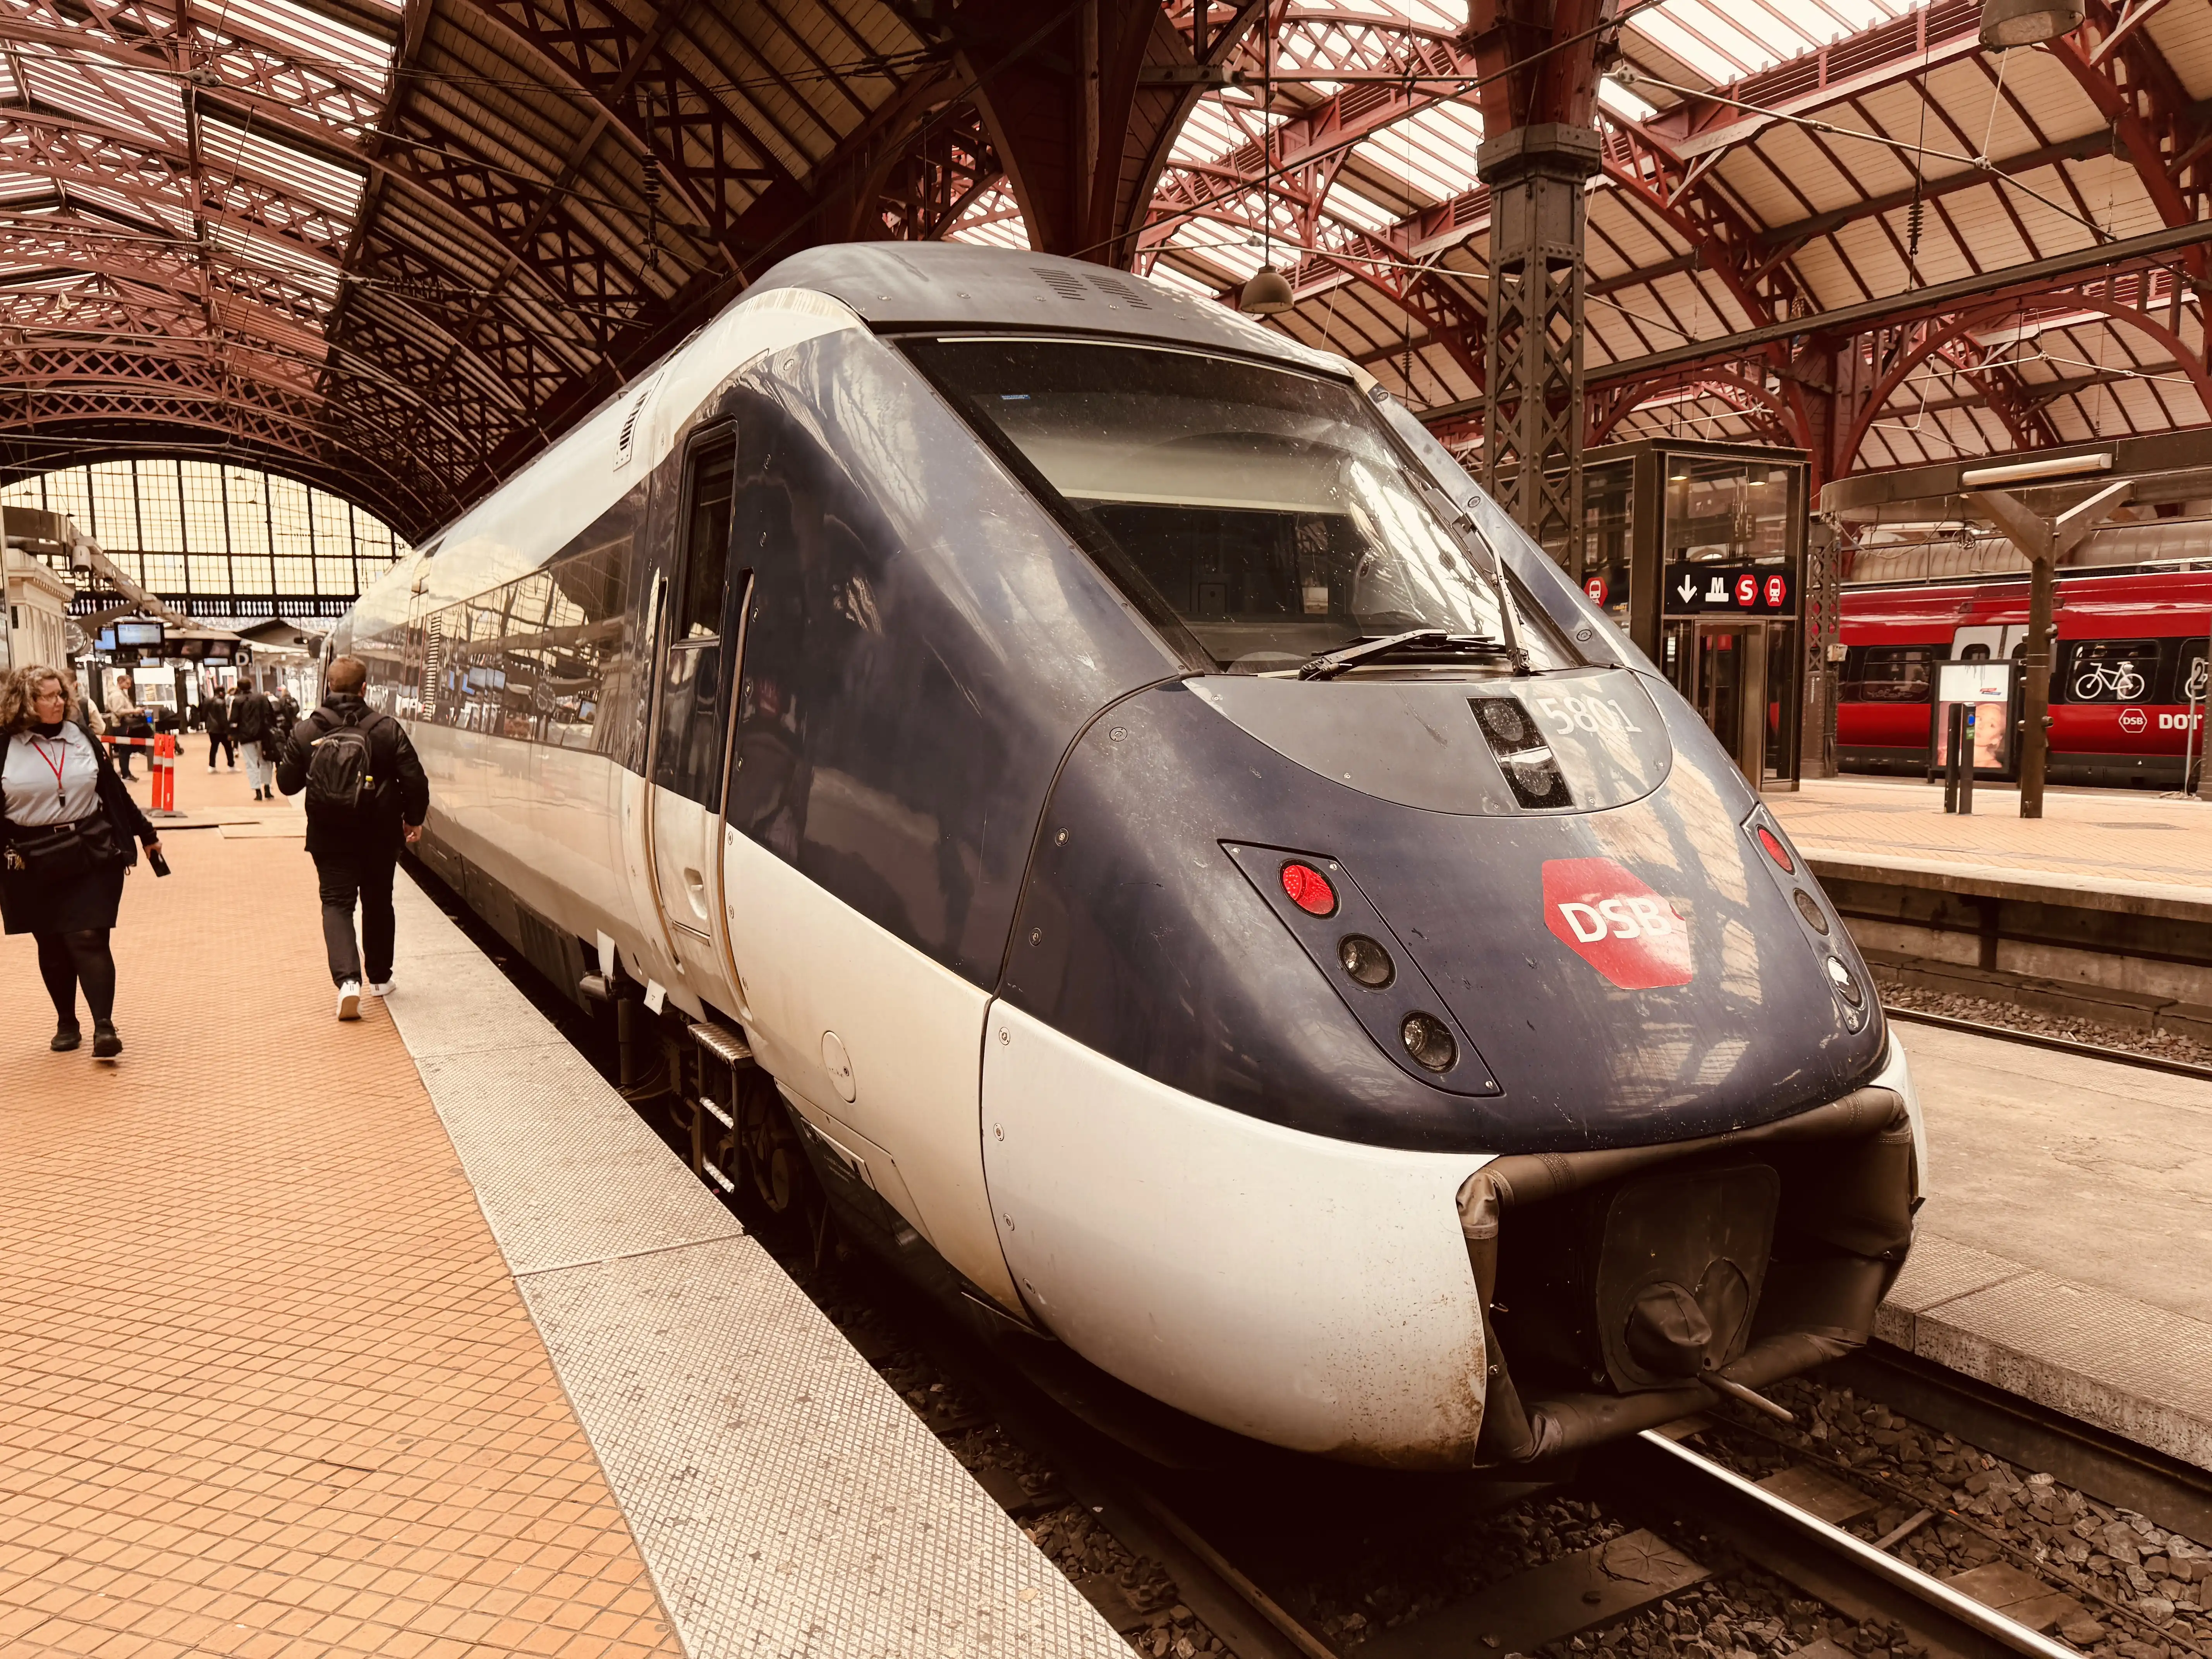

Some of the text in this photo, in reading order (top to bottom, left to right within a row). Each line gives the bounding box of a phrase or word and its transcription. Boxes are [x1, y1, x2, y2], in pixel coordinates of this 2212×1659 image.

[1711, 577, 1753, 600] M S
[235, 652, 249, 666] D
[2194, 662, 2203, 685] 2
[1536, 696, 1642, 734] 5801
[2123, 717, 2144, 725] DSB
[1558, 897, 1672, 943] DSB
